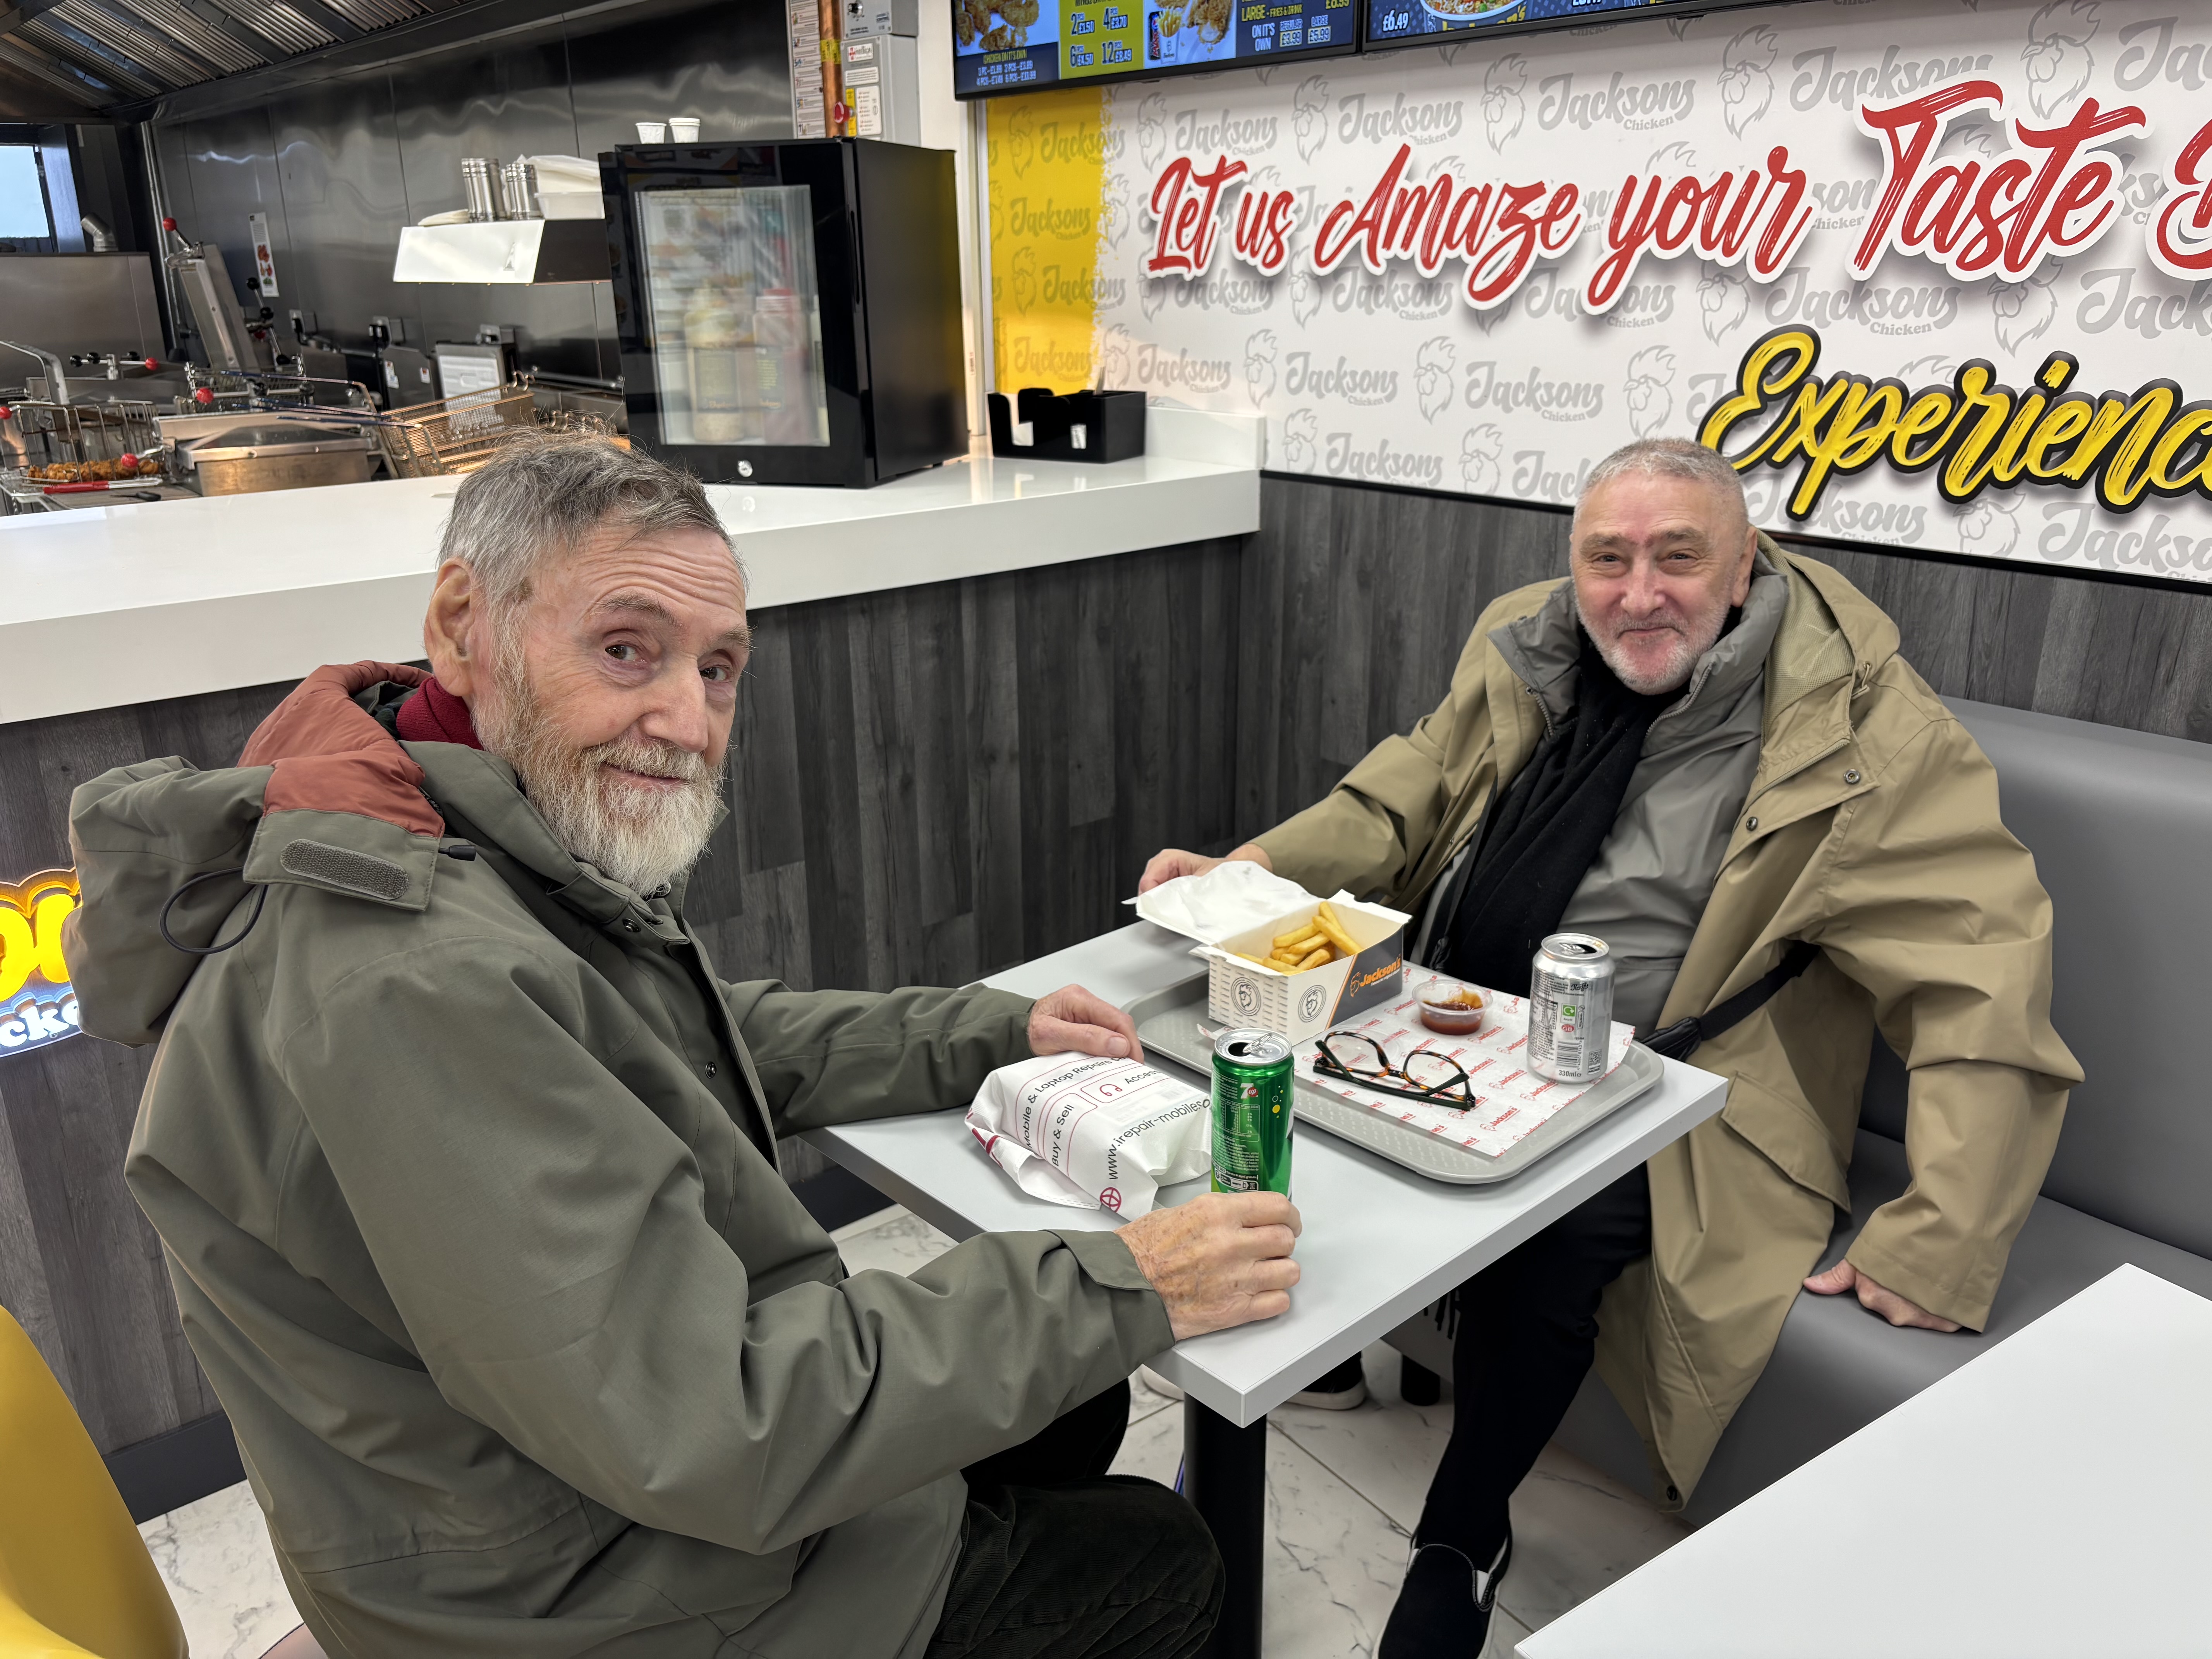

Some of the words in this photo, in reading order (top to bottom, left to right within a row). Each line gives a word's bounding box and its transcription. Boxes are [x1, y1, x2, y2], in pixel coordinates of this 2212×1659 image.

[1071, 12, 1078, 36] 2
[1103, 7, 1110, 30] 4
[1242, 5, 1266, 21] LARGE
[1382, 10, 1409, 32] £6.49
[1070, 45, 1077, 68] 6
[1102, 41, 1114, 65] 12
[1537, 72, 1696, 131] Jacksons
[1175, 109, 1278, 155] Jacksons
[1338, 93, 1463, 144] Jacksons
[1623, 117, 1674, 131] Chicken
[1148, 154, 1248, 273] Let
[1235, 191, 1294, 269] us
[1314, 143, 1581, 302] Amaze
[1587, 146, 1813, 306] your
[1853, 80, 2147, 273] Taste
[1010, 197, 1091, 237] Jacksons
[1042, 265, 1126, 306] Jacksons
[1175, 268, 1274, 310] Jacksons
[1332, 267, 1453, 316] Jacksons
[1764, 268, 1961, 329] Jacksons
[1399, 309, 1437, 321] Chicken
[1607, 316, 1654, 328] Chicken
[1869, 321, 1932, 335] Chicken
[1138, 344, 1231, 390] Jacksons
[1285, 352, 1398, 402] Jacksons
[1347, 394, 1384, 407] Chicken
[1465, 361, 1604, 419] Jacksons
[1541, 409, 1587, 422] Chicken
[1326, 433, 1443, 486] Jacksons
[1360, 957, 1401, 987] Jackson's
[1023, 1106, 1032, 1149] Mobile
[1035, 1071, 1074, 1092] Laptop
[1072, 1059, 1113, 1075] Repairs
[1056, 1104, 1075, 1125] Sell
[1052, 1141, 1061, 1167] Buy
